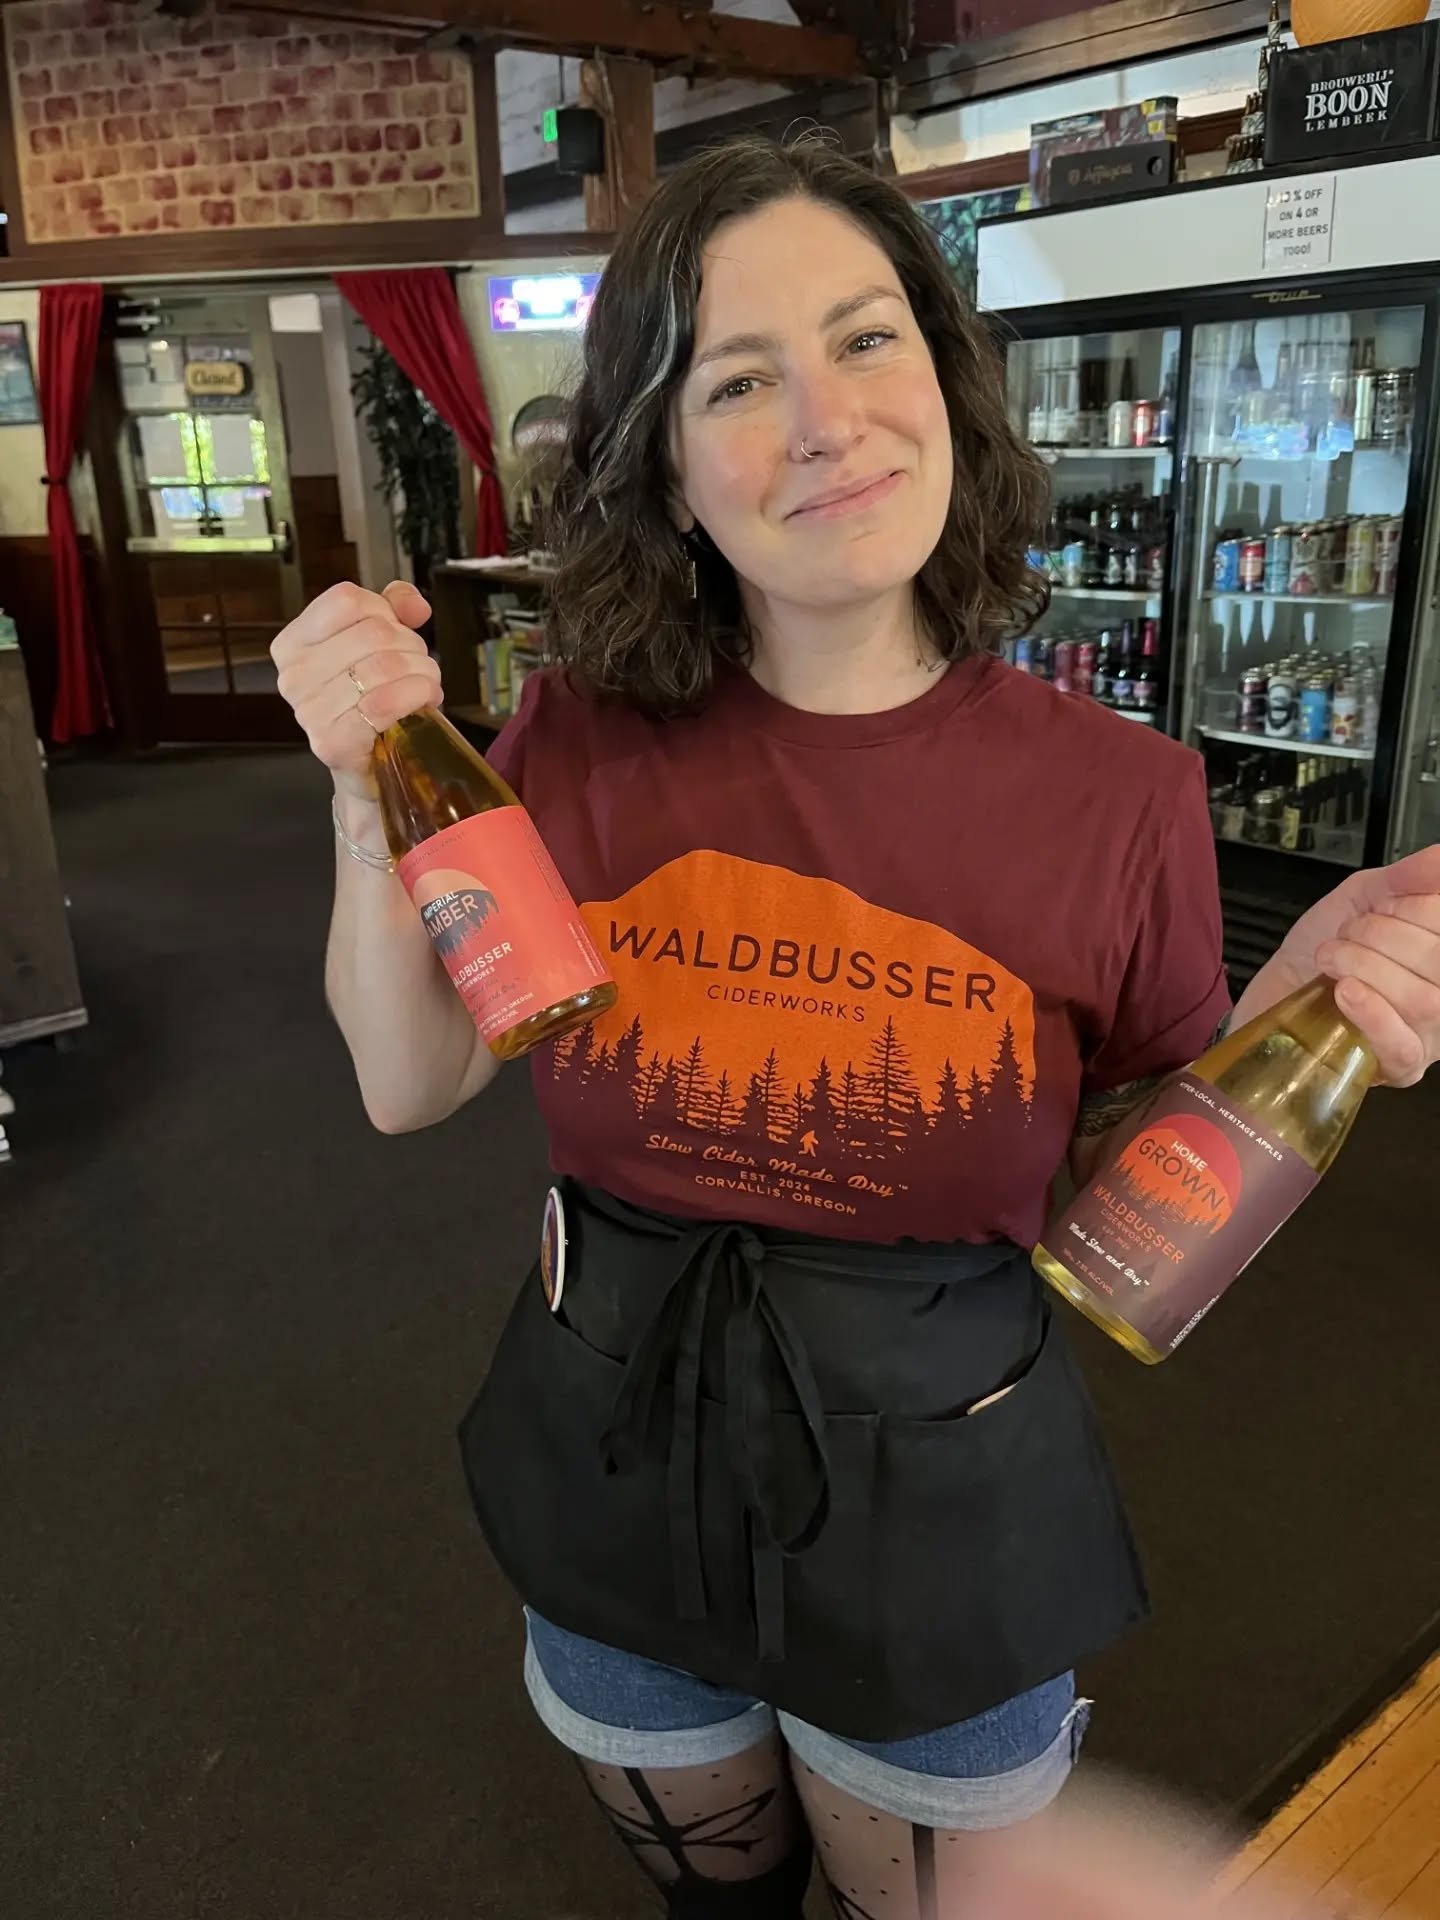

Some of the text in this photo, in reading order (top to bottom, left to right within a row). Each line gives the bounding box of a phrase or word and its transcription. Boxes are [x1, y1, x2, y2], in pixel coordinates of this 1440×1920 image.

[1304, 81, 1392, 120] BOON
[1305, 110, 1387, 132] LEMBEEK
[1279, 206, 1319, 221] ON 4 OR
[1304, 188, 1323, 200] OFF
[1268, 224, 1328, 240] MORE BEERS
[426, 894, 479, 939] AMBER
[610, 920, 996, 1013] WALDBUSSER
[707, 984, 865, 1022] CIDERWORKS
[1218, 1107, 1256, 1138] HERITAGE
[1255, 1137, 1283, 1161] APPLES
[645, 1134, 692, 1154] Slow
[703, 1145, 758, 1167] Cider
[768, 1158, 836, 1183] Made
[1138, 1138, 1226, 1212] GROWN
[1171, 1140, 1208, 1172] HOME
[779, 1178, 811, 1192] 2024
[792, 1192, 856, 1215] OREGON
[1093, 1184, 1184, 1264] WALDBUSSER
[1100, 1207, 1152, 1253] CIDERWORKS
[1069, 1222, 1087, 1241] Made
[1085, 1238, 1105, 1255] Slow
[1105, 1254, 1126, 1271] and
